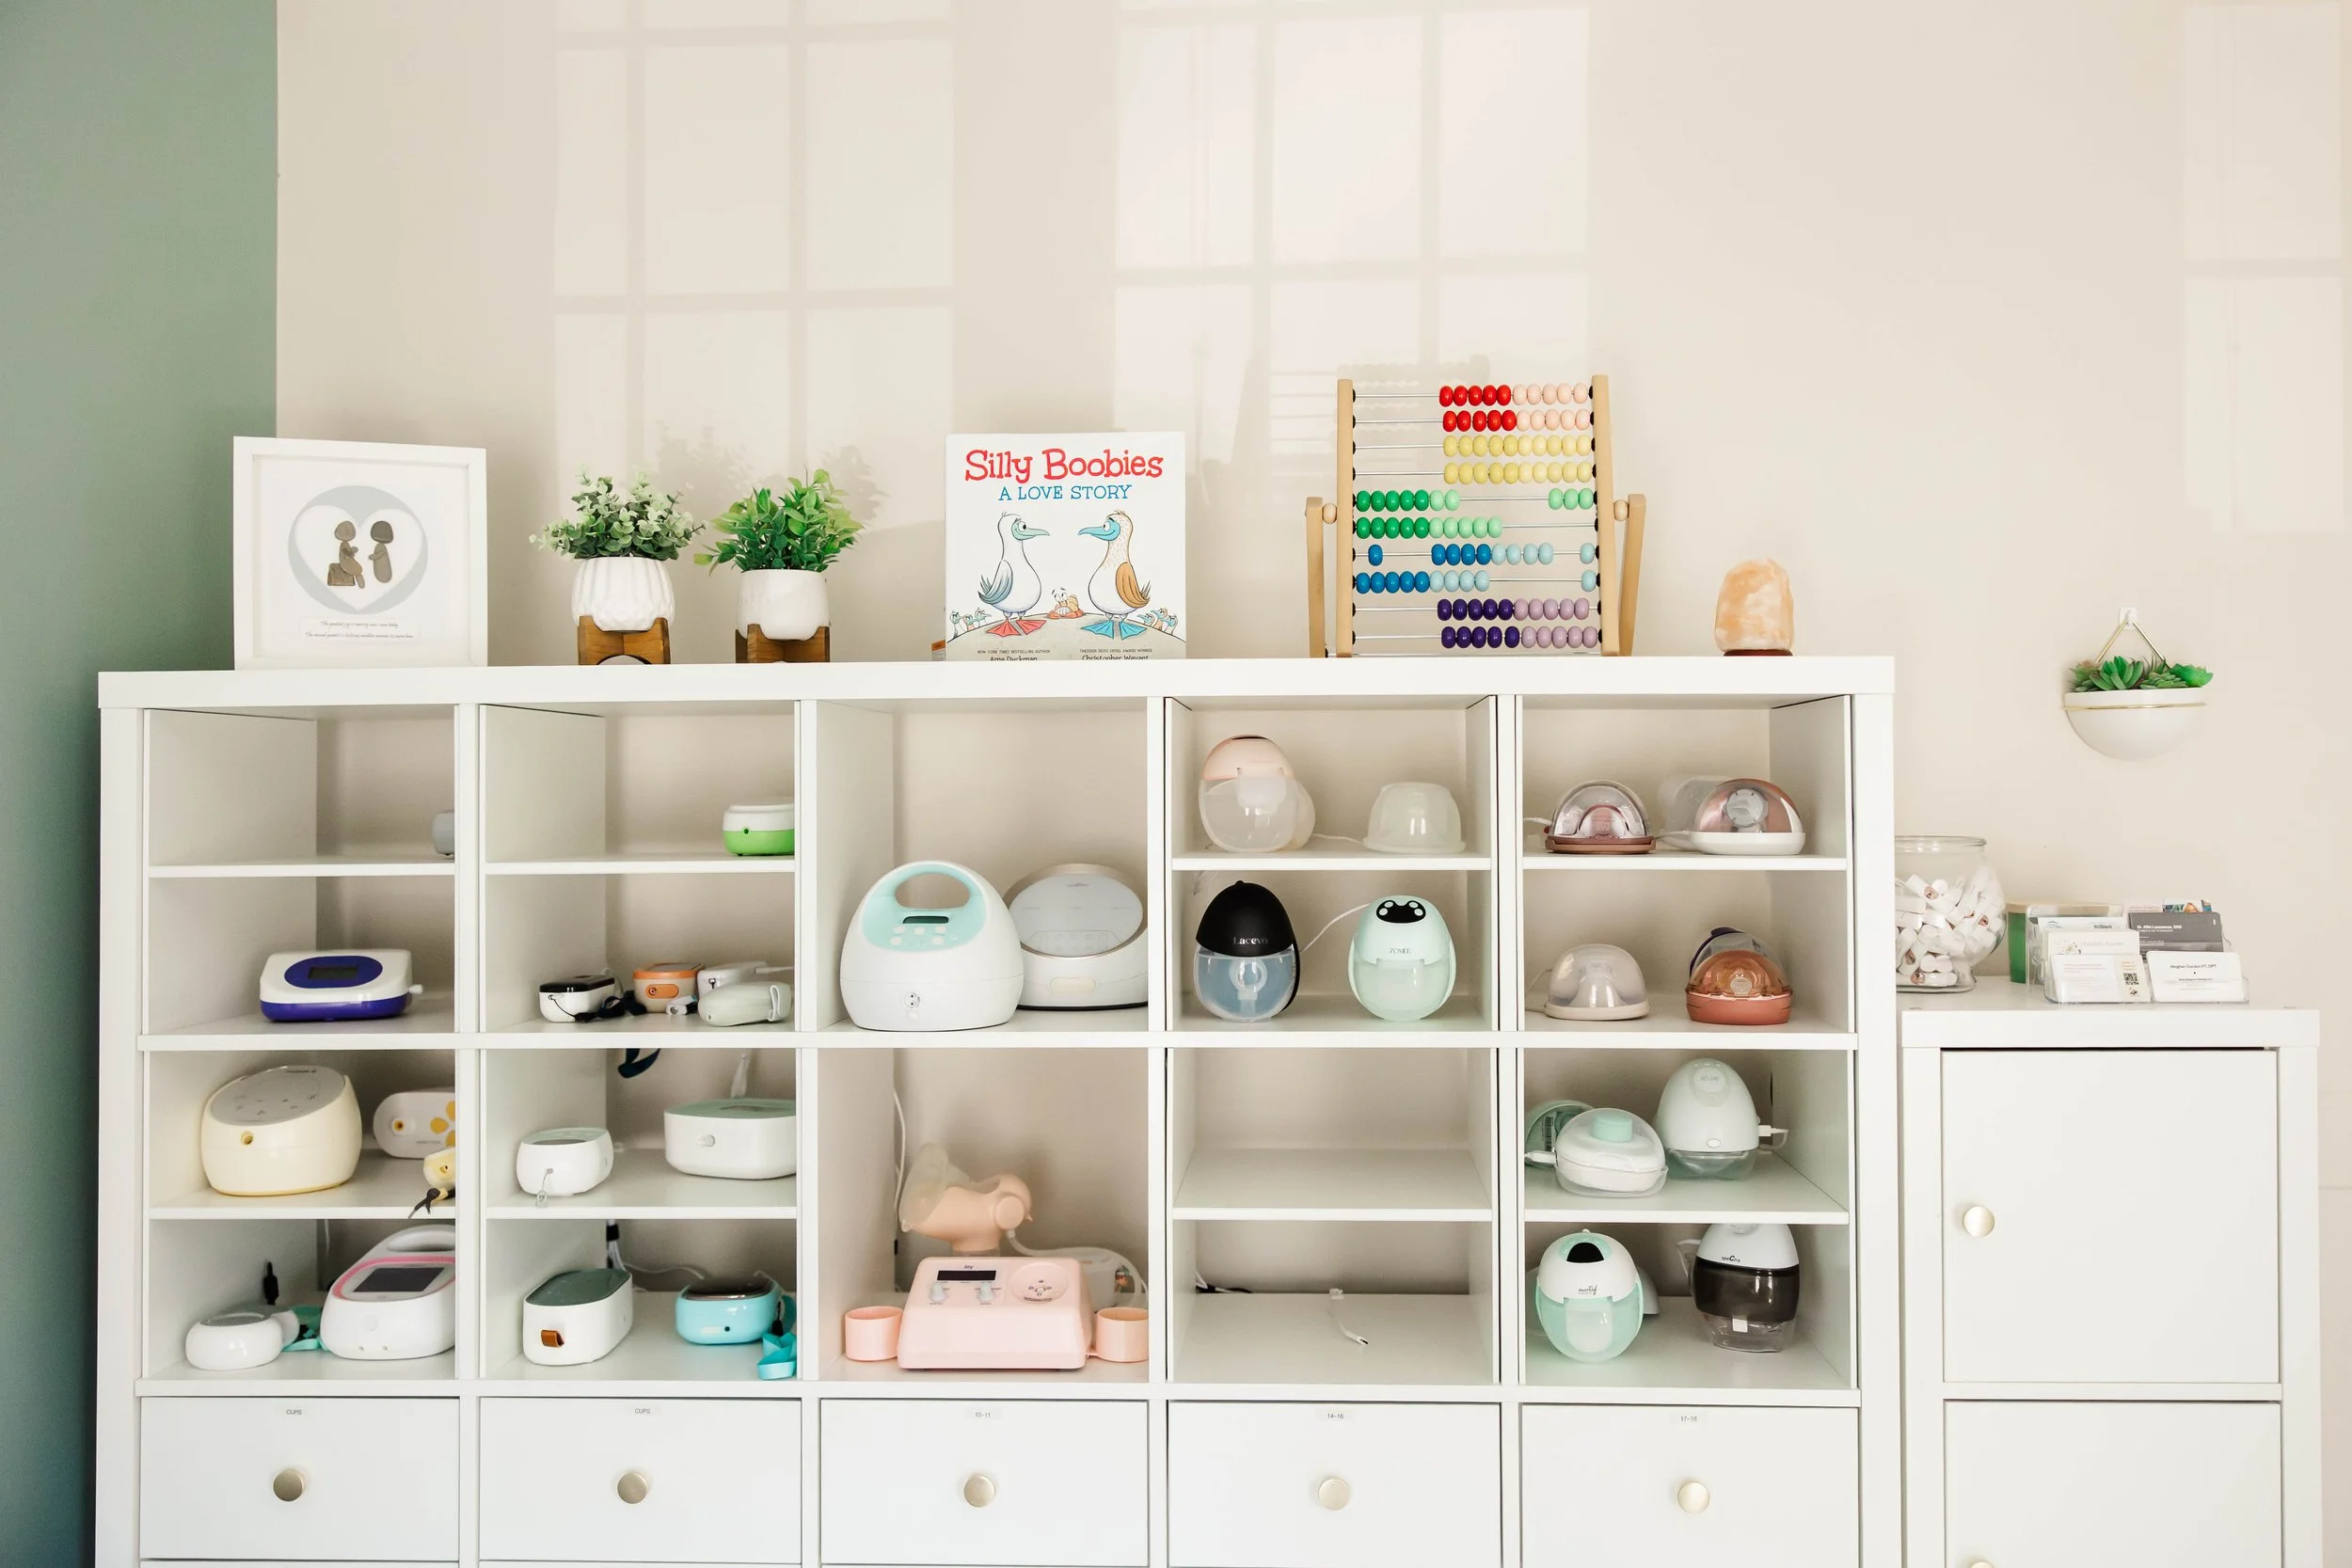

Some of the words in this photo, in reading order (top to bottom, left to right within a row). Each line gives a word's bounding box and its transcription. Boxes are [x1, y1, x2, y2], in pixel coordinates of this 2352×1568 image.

[965, 449, 1033, 484] Silly
[1041, 448, 1164, 480] Boobies
[998, 486, 1011, 500] A
[1018, 485, 1063, 499] LOVE
[1071, 484, 1132, 499] STORY
